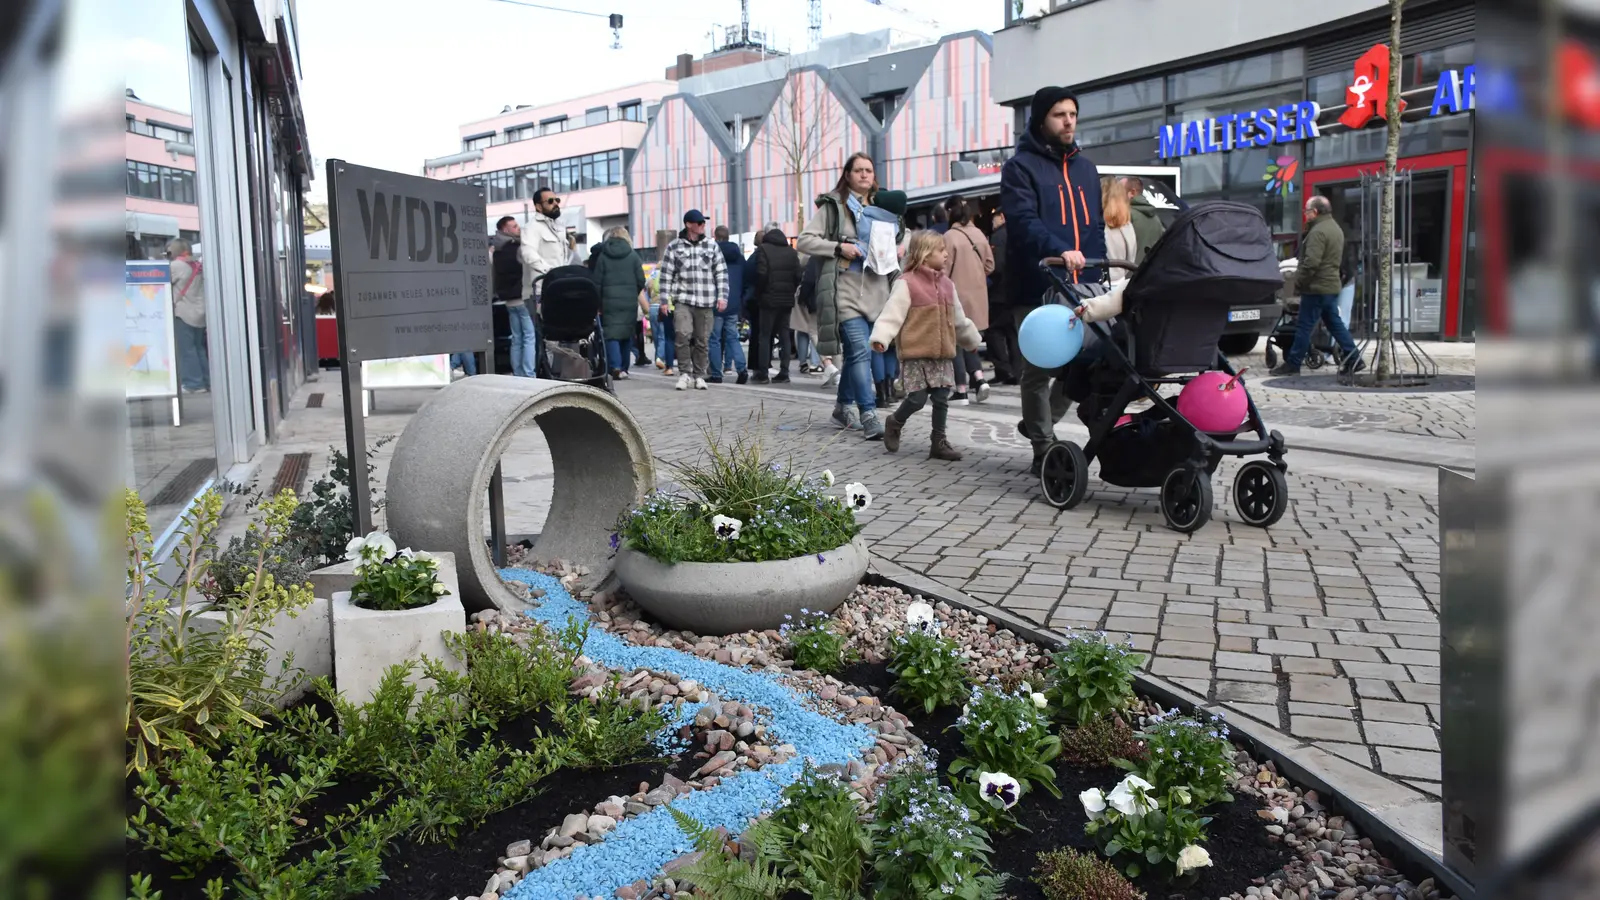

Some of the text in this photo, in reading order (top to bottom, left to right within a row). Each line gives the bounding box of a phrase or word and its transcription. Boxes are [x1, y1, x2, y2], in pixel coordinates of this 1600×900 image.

[1158, 100, 1320, 158] MALTESER
[460, 204, 484, 217] WESER
[356, 188, 459, 264] WDB
[461, 220, 485, 234] DIEMEL
[462, 237, 486, 250] BETON
[463, 254, 487, 266] & KIES
[358, 290, 397, 302] ZUSAMMEN
[401, 288, 423, 299] NEUES
